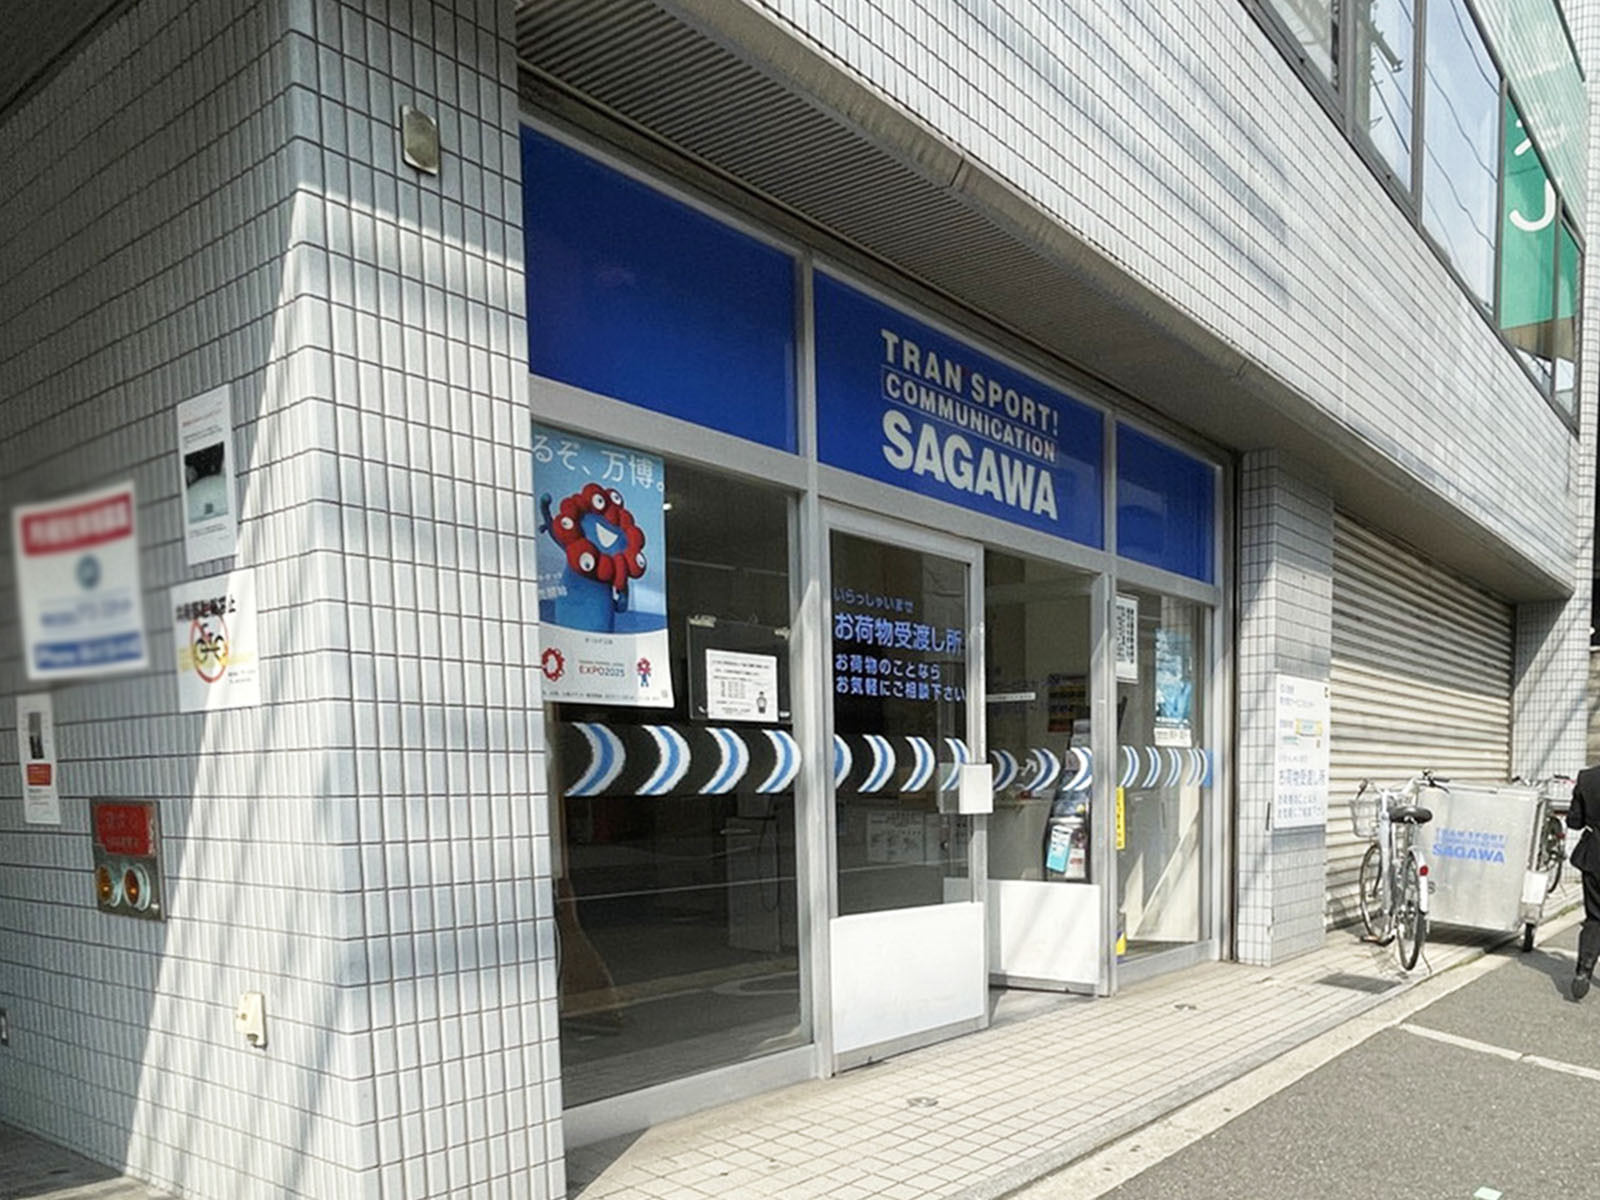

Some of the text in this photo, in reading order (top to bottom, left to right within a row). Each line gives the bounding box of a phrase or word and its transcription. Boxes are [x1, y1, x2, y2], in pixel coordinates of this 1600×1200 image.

[881, 328, 1058, 436] TRAN SPORT!
[886, 372, 1056, 462] COMMUNICATION
[883, 410, 1058, 521] SAGAWA
[834, 612, 963, 655] お荷物受渡し所
[579, 665, 625, 678] EXPO2025
[835, 653, 941, 680] お荷物のことなら
[836, 675, 966, 703] お気軽にご相談下さい
[1432, 843, 1505, 863] SAGAWA
